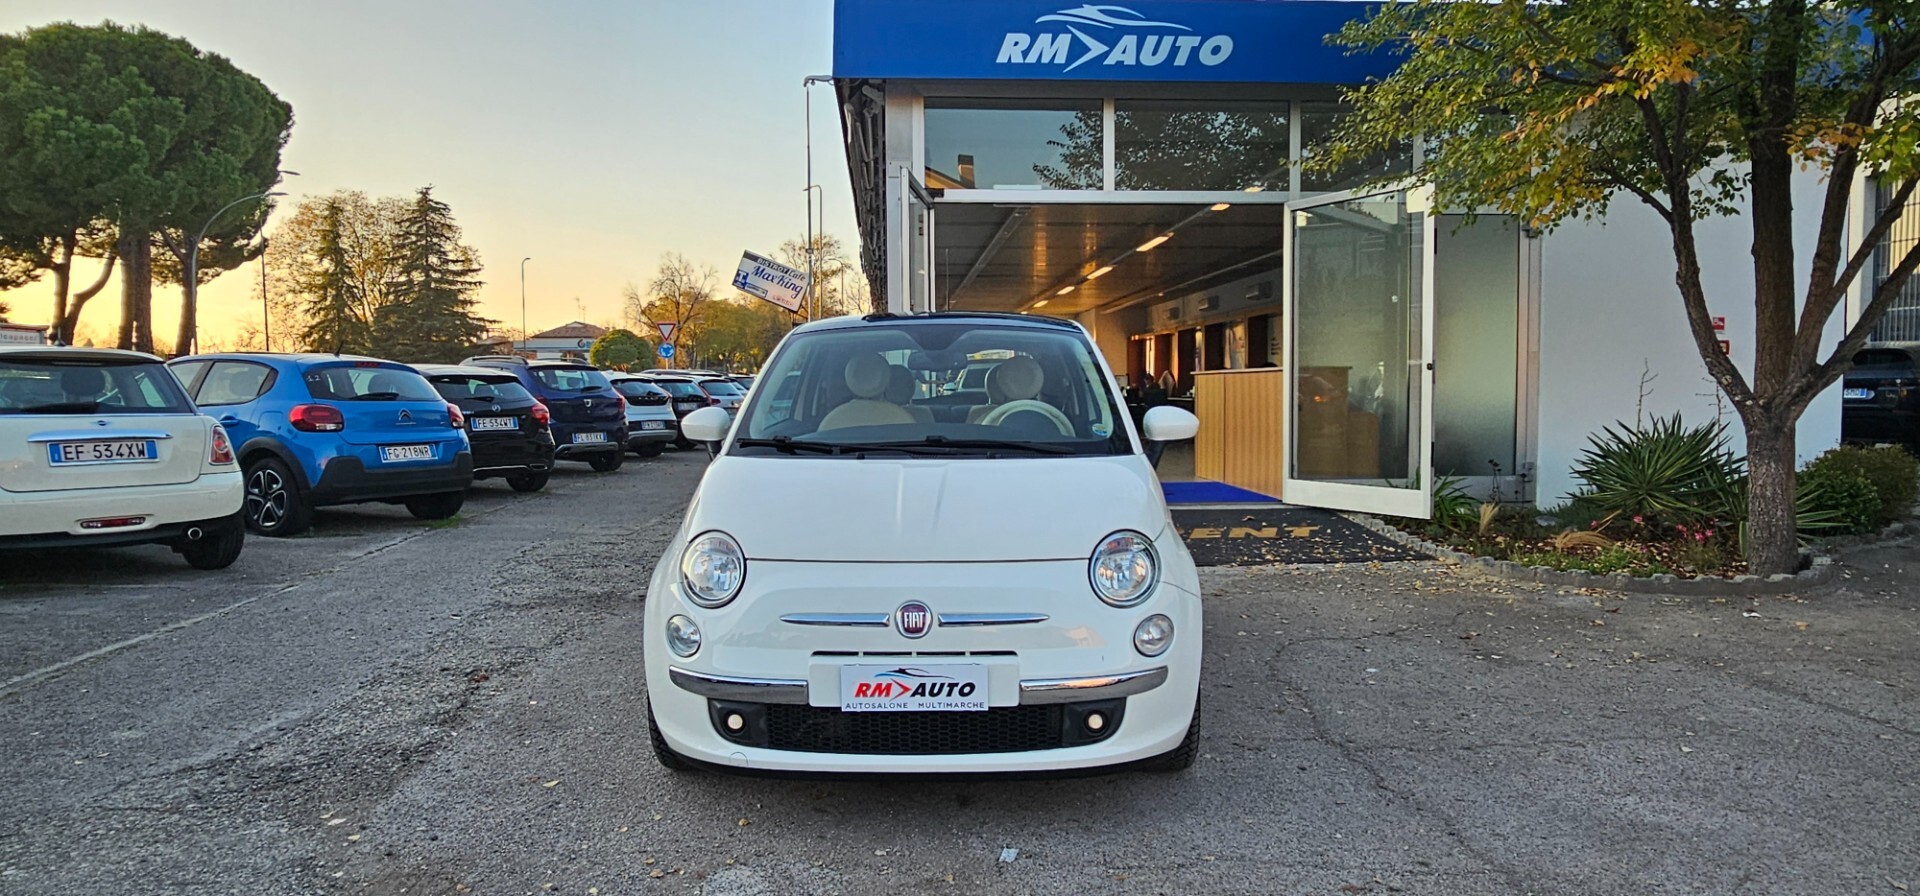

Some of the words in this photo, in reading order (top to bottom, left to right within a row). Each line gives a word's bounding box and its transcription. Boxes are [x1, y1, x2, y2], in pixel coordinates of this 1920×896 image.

[996, 32, 1072, 64] RM
[1103, 34, 1234, 67] AUTO
[63, 444, 85, 461] EF
[92, 442, 146, 459] 534XW
[401, 446, 430, 458] 218NR
[1176, 525, 1321, 540] ENT
[903, 611, 925, 629] FIAT
[854, 682, 893, 698] RM
[910, 681, 976, 698] AUTO
[845, 702, 909, 710] AUTOSALONE
[918, 701, 985, 709] MULTIMARCHE
